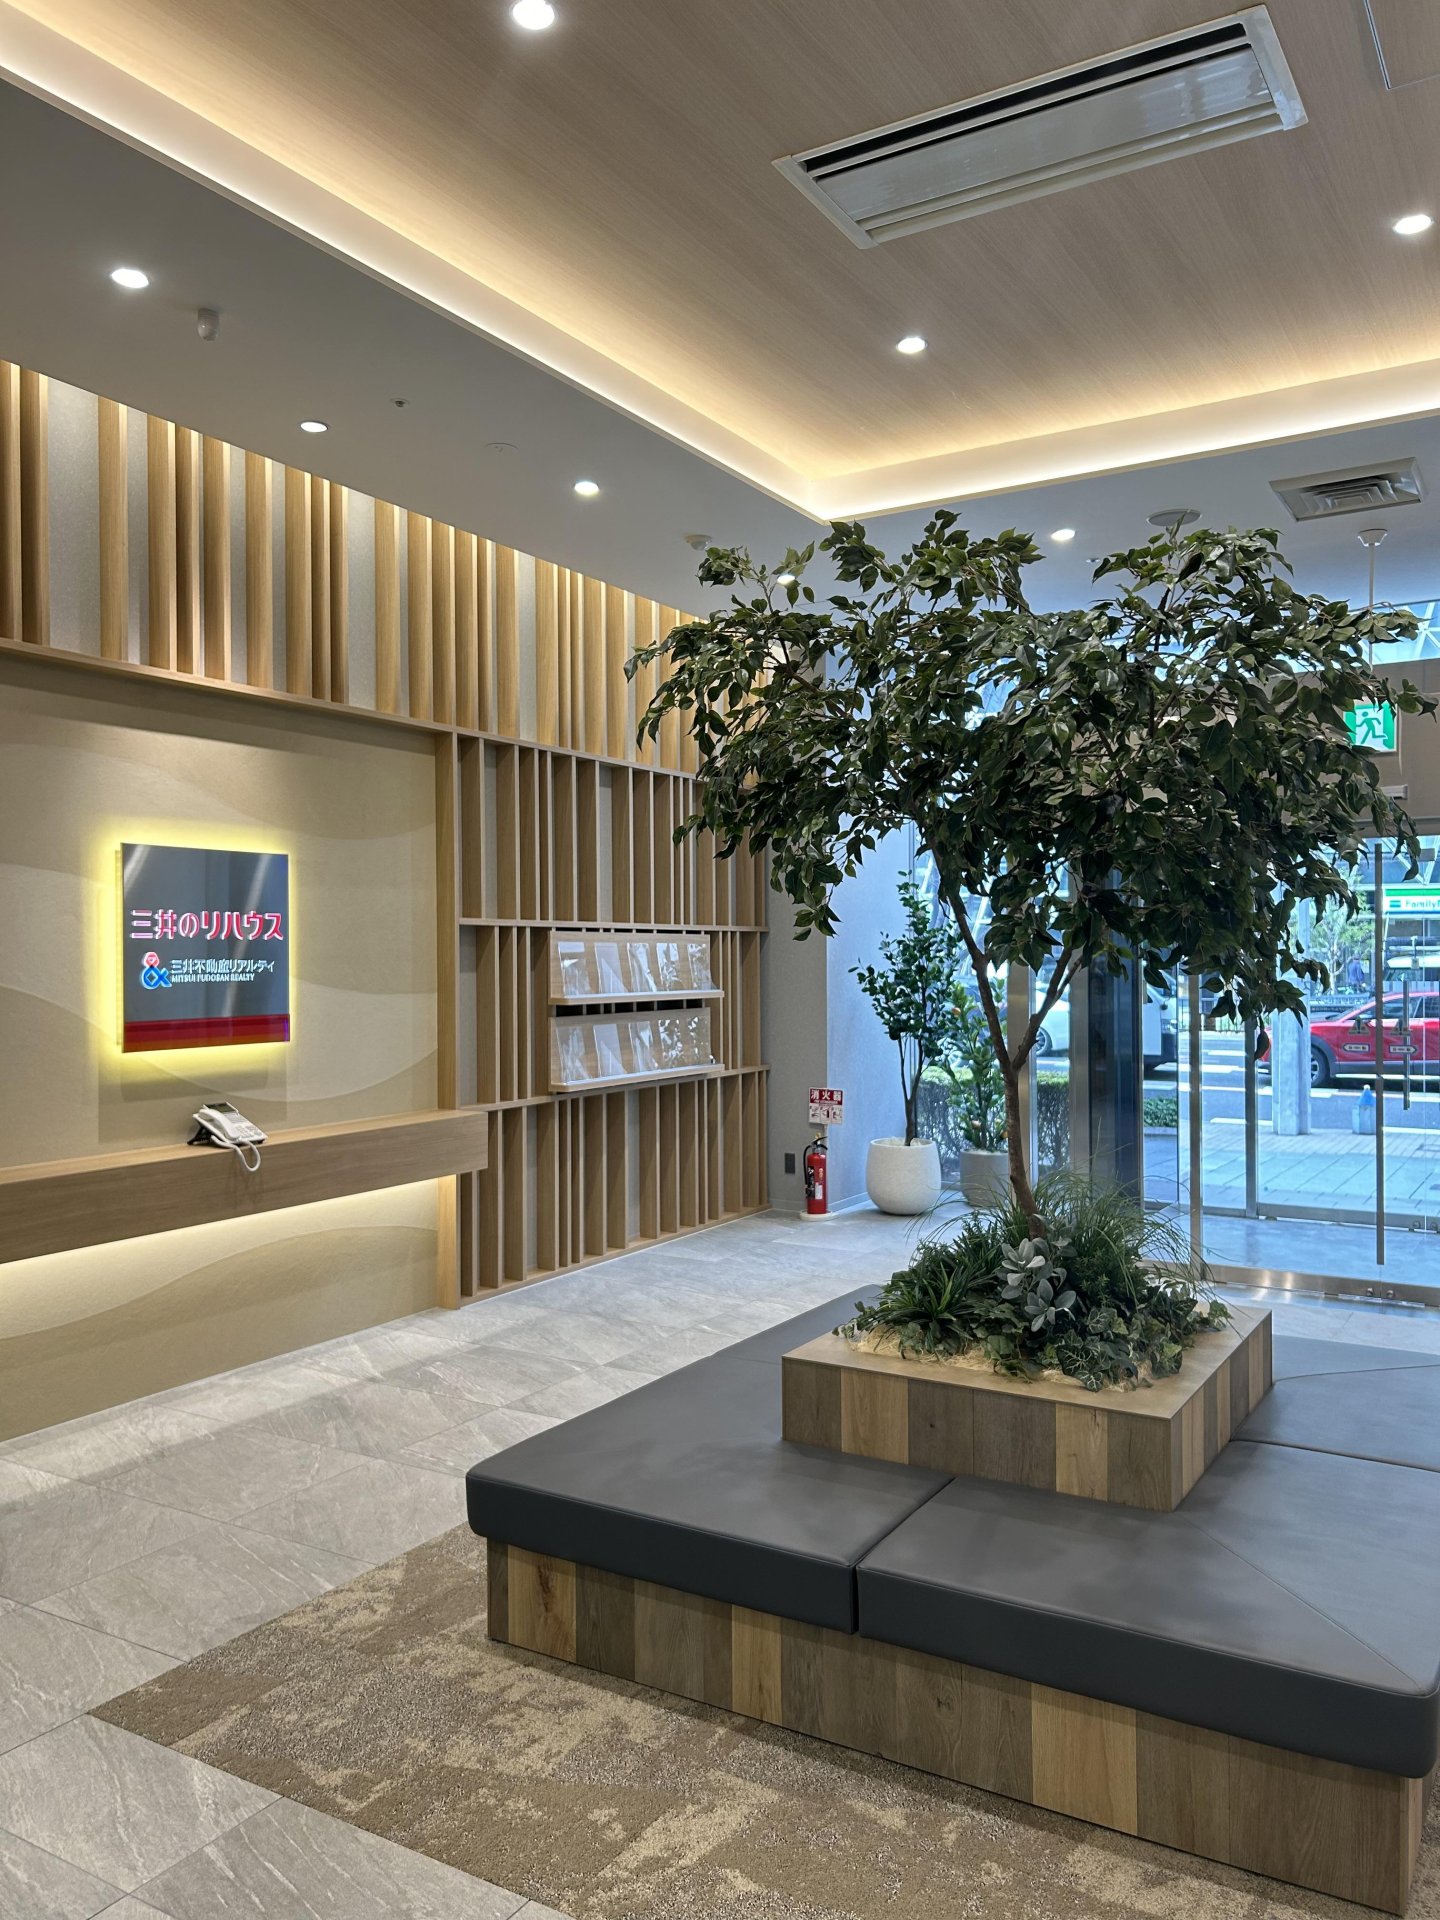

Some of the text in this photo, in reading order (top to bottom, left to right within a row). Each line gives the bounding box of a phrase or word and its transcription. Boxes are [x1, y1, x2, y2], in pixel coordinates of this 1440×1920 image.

[130, 909, 284, 940] 三井のリハウス
[810, 1089, 842, 1101] 消火器
